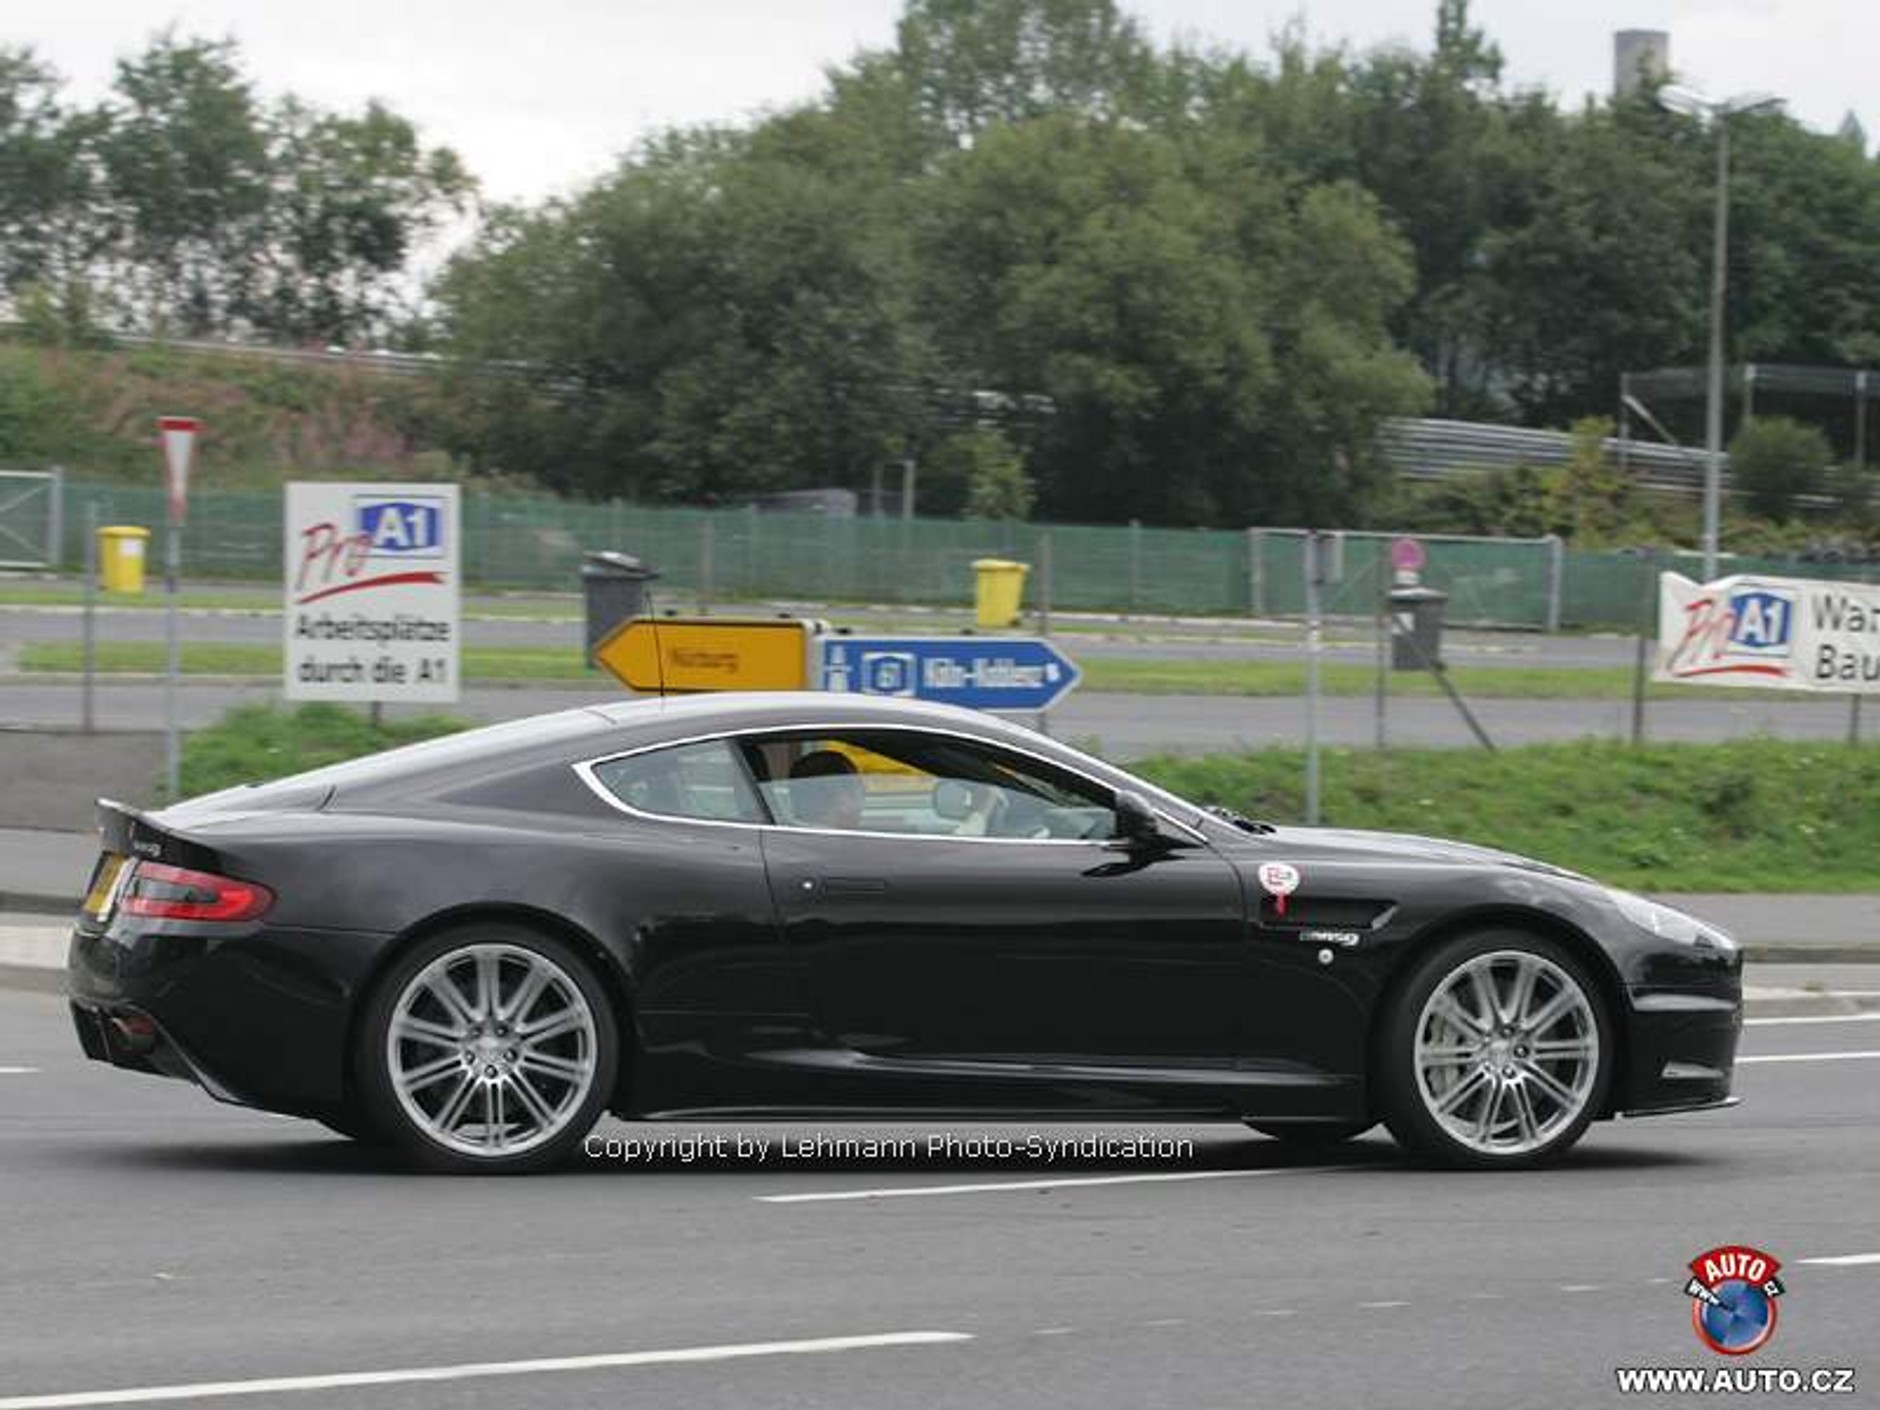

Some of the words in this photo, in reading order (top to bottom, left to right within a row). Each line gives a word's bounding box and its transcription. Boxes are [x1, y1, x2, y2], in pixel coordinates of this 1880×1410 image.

[375, 507, 427, 547] A1
[1736, 599, 1783, 645] A1
[299, 656, 363, 684] durch
[372, 656, 406, 684] die
[415, 658, 446, 684] A1
